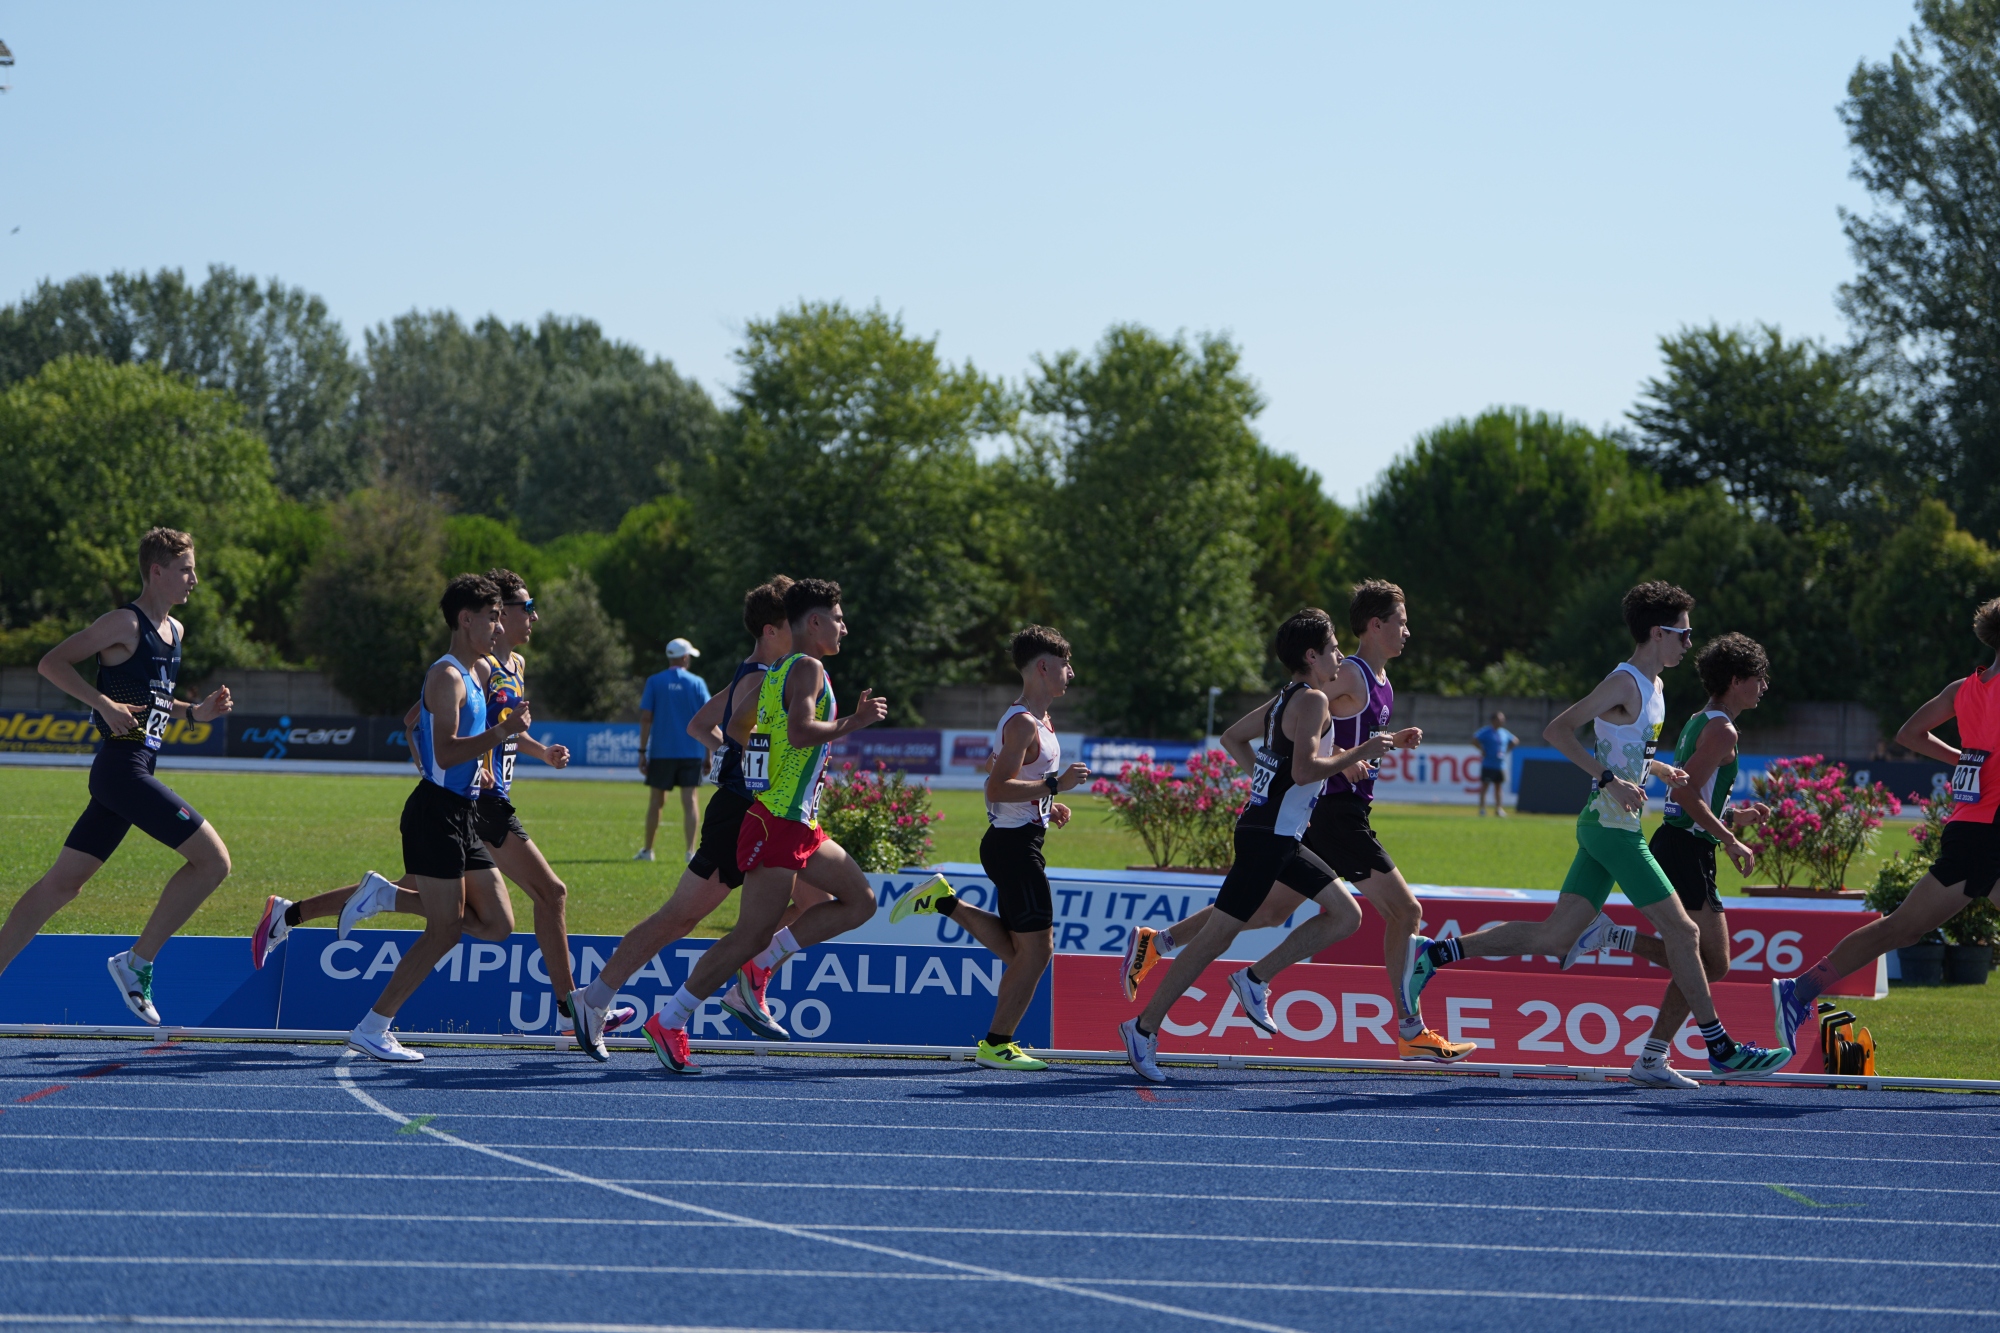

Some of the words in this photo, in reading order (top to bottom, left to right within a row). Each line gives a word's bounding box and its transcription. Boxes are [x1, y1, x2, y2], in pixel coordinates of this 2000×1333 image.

[155, 697, 174, 710] DRIV
[504, 743, 518, 751] DRIV
[587, 729, 651, 747] atletic
[587, 748, 640, 764] italian
[1378, 748, 1482, 793] eting
[1953, 767, 1978, 791] 207
[319, 939, 727, 990] CAMPIONAT
[780, 952, 1002, 996] TALIAN
[1158, 986, 1496, 1049] CAORE
[1517, 999, 1709, 1060] 2026
